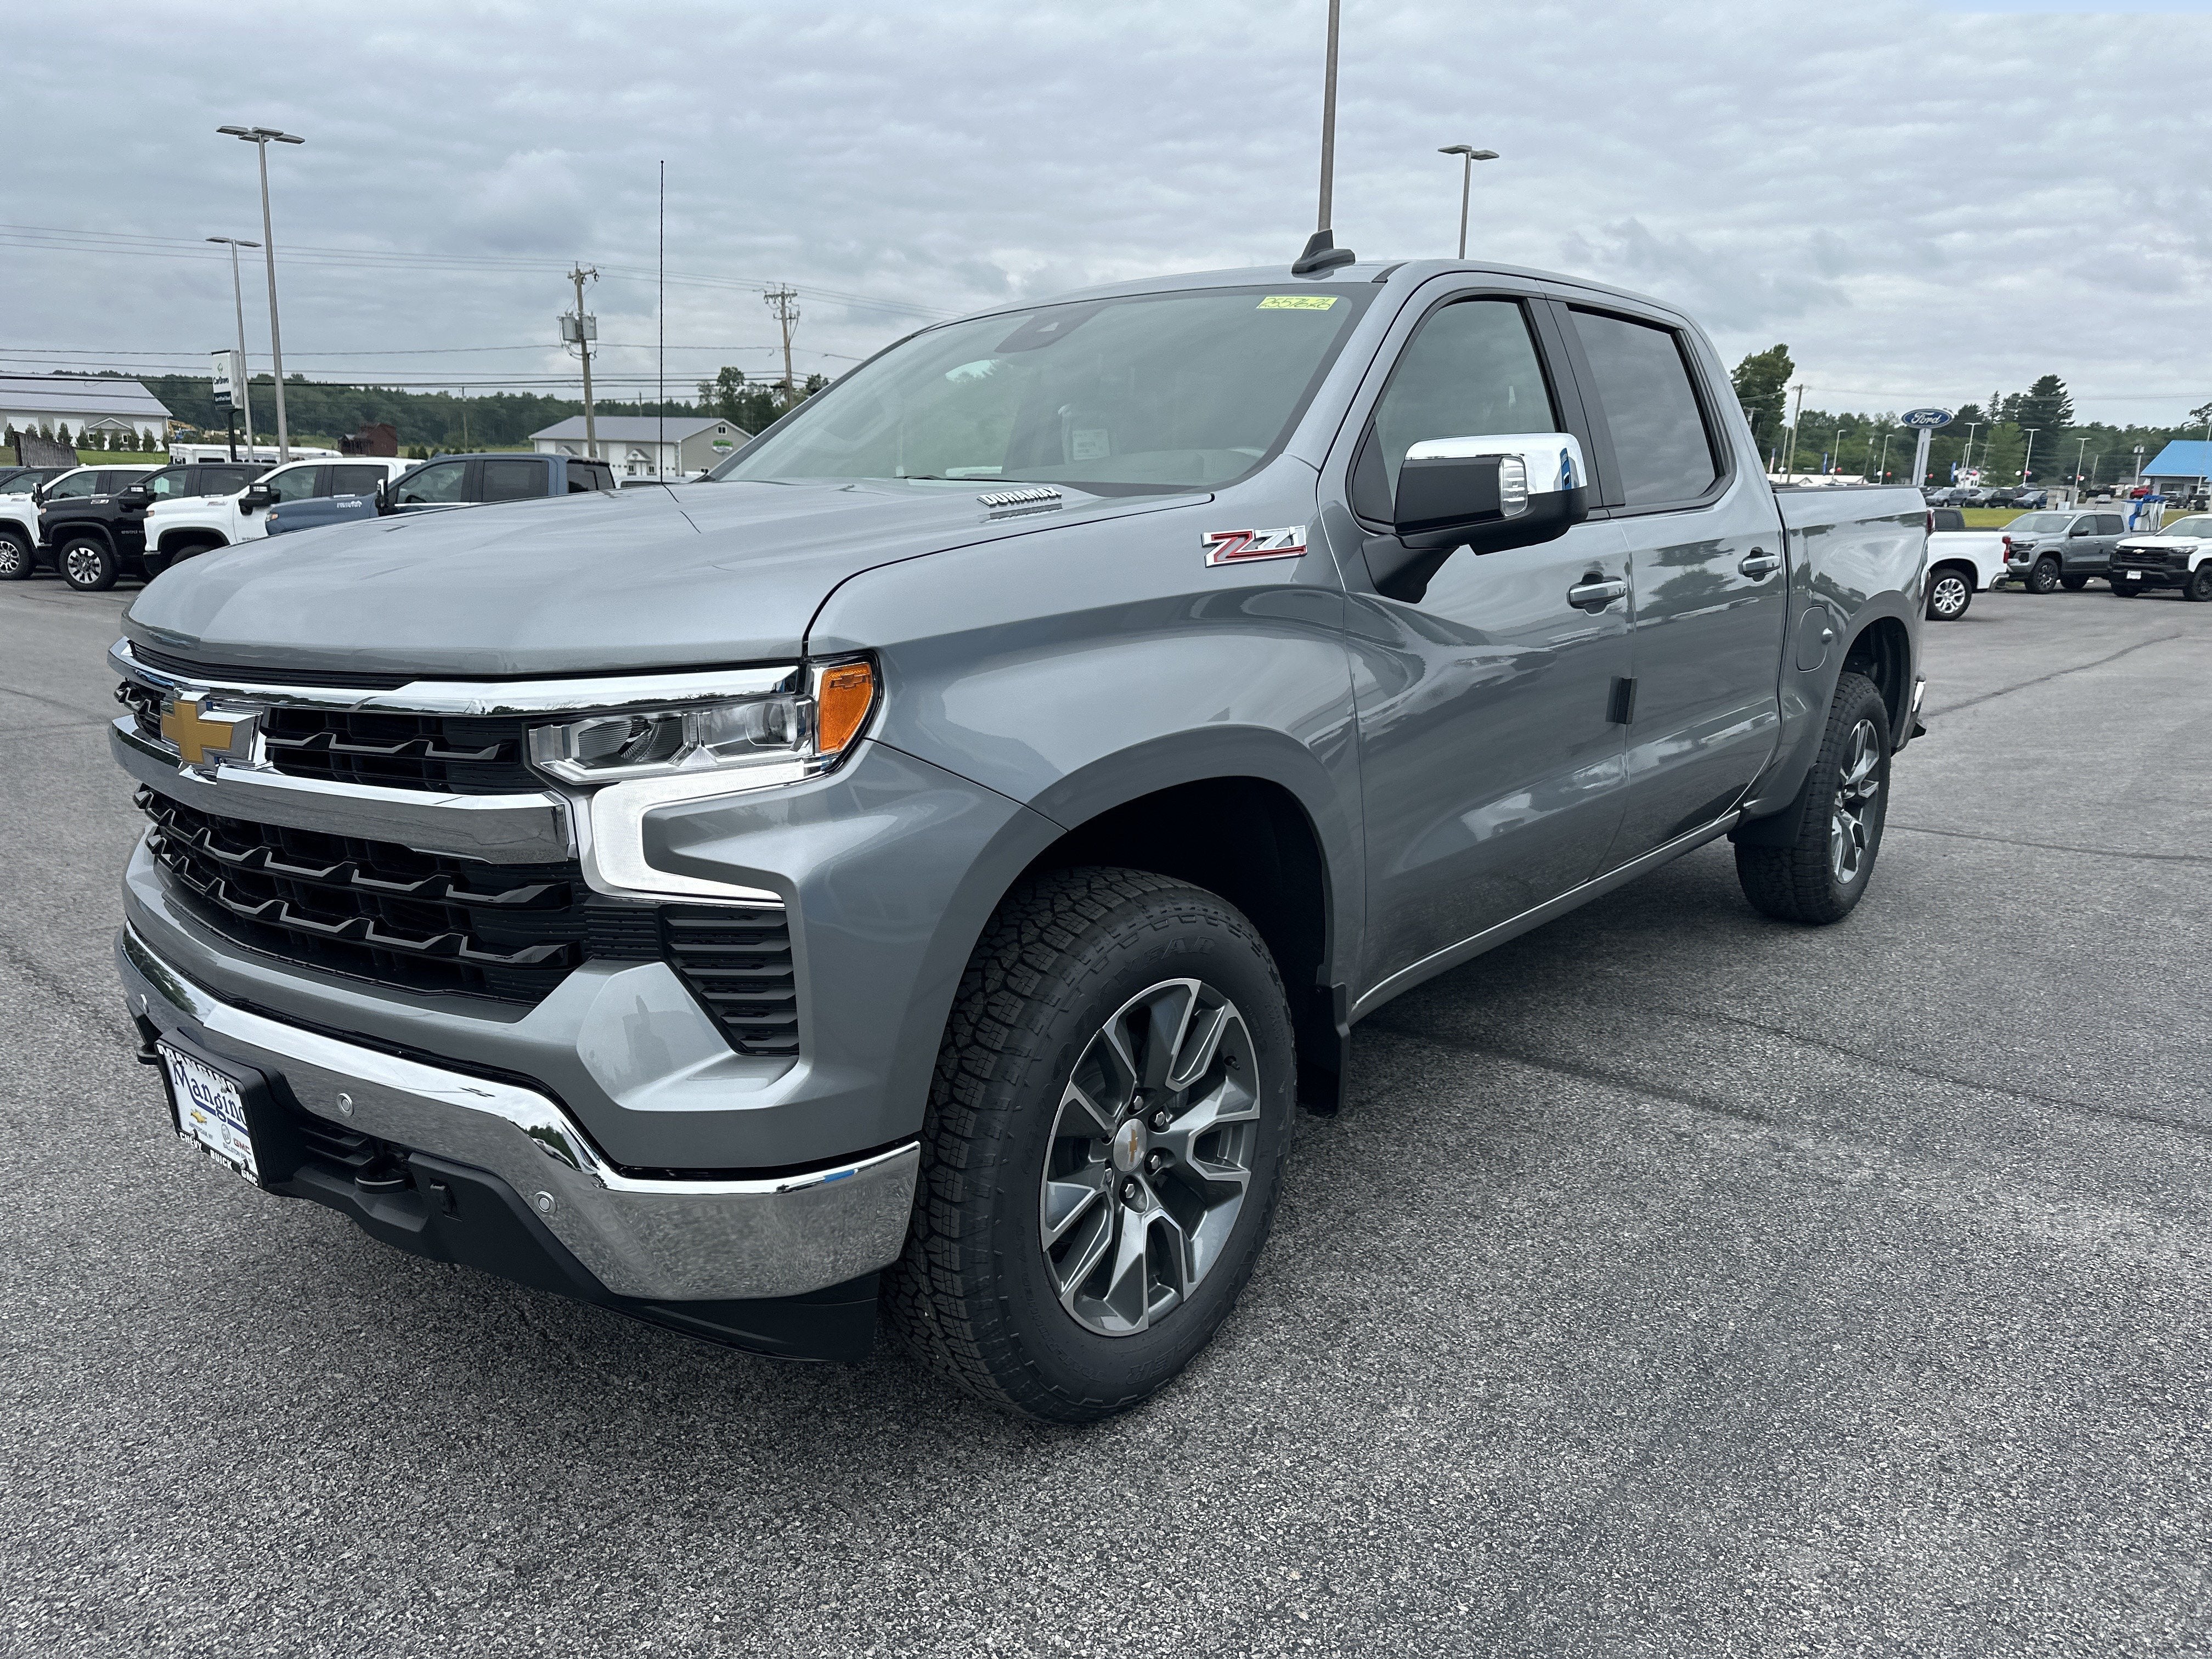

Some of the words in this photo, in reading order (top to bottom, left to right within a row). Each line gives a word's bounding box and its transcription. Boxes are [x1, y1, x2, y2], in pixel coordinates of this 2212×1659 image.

[1911, 411, 1942, 424] Ford
[977, 487, 1062, 506] DURAMAX
[1201, 525, 1308, 568] Z71
[233, 1137, 252, 1156] GMC
[179, 1132, 204, 1153] CHEVY
[210, 1149, 233, 1171] BUICK
[241, 1169, 258, 1187] GMC
